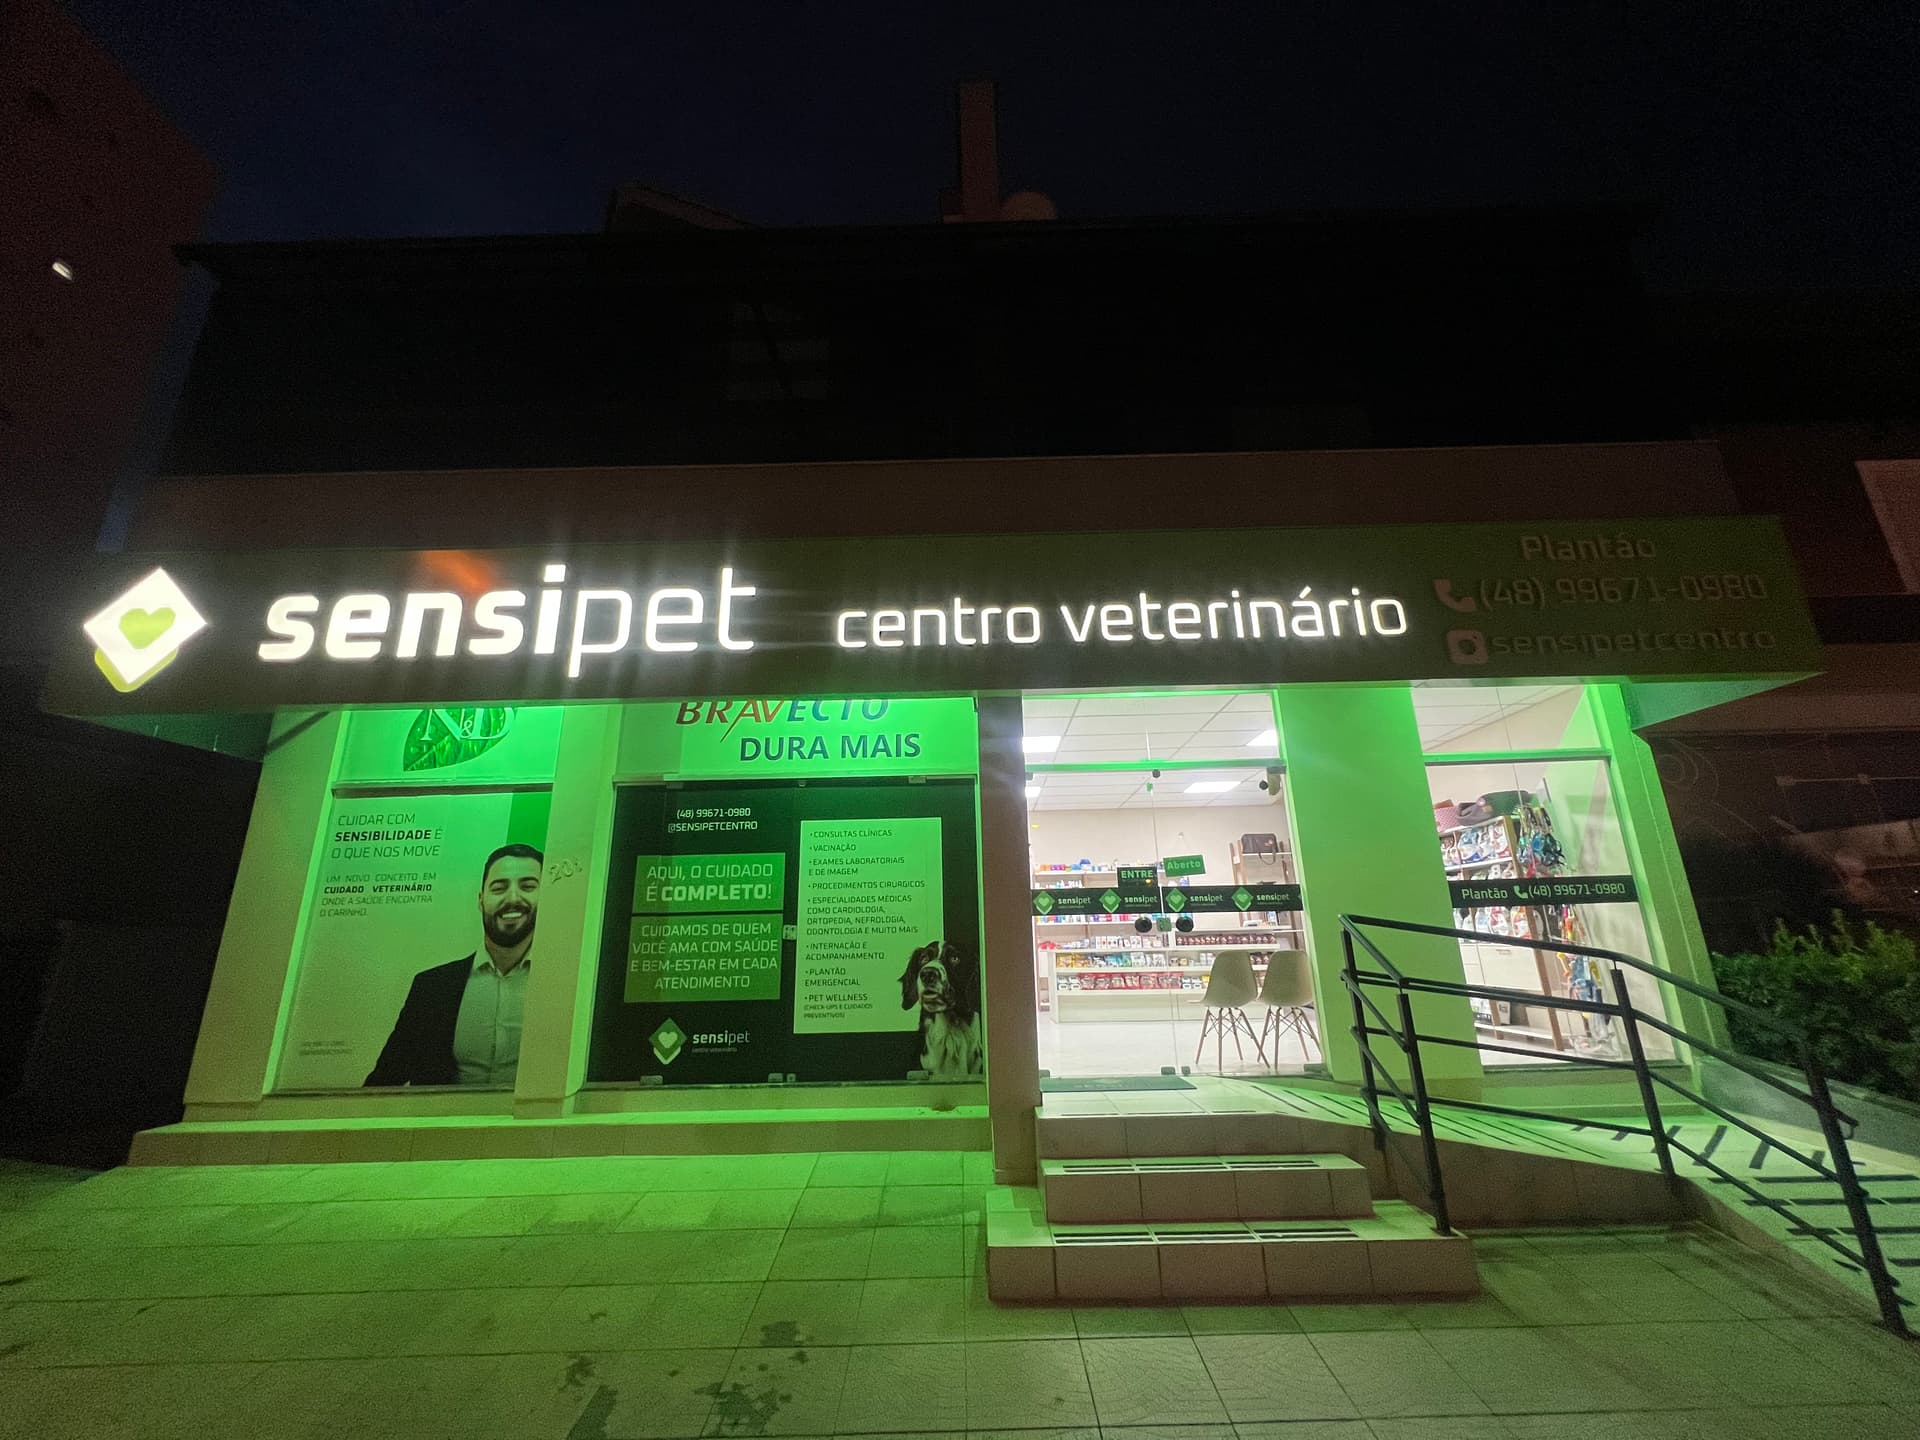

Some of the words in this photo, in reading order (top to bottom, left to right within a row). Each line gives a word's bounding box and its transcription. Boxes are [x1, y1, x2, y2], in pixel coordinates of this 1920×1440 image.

[1521, 533, 1656, 561] Plantão
[1480, 578, 1546, 610] (48)
[1555, 575, 1767, 602] 99671-0980
[259, 564, 756, 677] sensipet
[836, 598, 1042, 648] centro
[1060, 586, 1408, 642] veterinário
[1492, 628, 1776, 656] sensipetcentro
[675, 699, 889, 740] BRAVECTO
[740, 736, 829, 761] DURA
[841, 733, 920, 758] MAIS
[677, 809, 694, 819] (48)
[696, 808, 751, 817] 99671-0980
[338, 815, 384, 825] CUIDAR
[387, 814, 415, 824] COM
[668, 821, 758, 833] @SENSIPETCENTRO
[335, 830, 432, 841] SENSIBILIDADE
[435, 826, 443, 839] É
[859, 828, 892, 837] CLÍNICAS
[332, 848, 340, 858] O
[344, 847, 371, 860] QUE
[374, 846, 399, 857] NOS
[403, 845, 440, 856] MOVE
[813, 844, 856, 852] VACINAÇÃO
[846, 857, 904, 865] LABORATORIAIS
[1168, 861, 1200, 869] Aberto
[345, 874, 370, 882] NOVO
[375, 873, 418, 882] CONCEITO
[423, 872, 436, 880] EM
[647, 866, 685, 881] AQUI,
[691, 866, 700, 878] O
[706, 864, 773, 877] CUIDADO
[815, 868, 825, 876] DE
[1121, 870, 1153, 878] ENTRE
[324, 886, 364, 894] CUIDADO
[373, 883, 432, 892] VETERINÁRIO
[880, 880, 925, 888] CIRÚRGICOS
[647, 882, 658, 901] É
[662, 884, 771, 901] COMPLETO!
[1462, 886, 1508, 900] Plantão
[1528, 886, 1551, 898] (48)
[1554, 883, 1626, 896] 99671-0980
[386, 896, 432, 904] ENCONTRA
[813, 896, 876, 904] ESPECIALIDADES
[878, 894, 912, 902] MÉDICAS
[1058, 896, 1091, 905] sensipet
[1124, 895, 1158, 904] sensipet
[1190, 894, 1222, 902] sensipet
[1257, 893, 1289, 901] sensipet
[320, 909, 326, 917] O
[833, 906, 885, 914] CARDIOLOGIA,
[807, 917, 853, 925] ORTOPEDIA,
[855, 916, 905, 924] NEFROLOGIA,
[642, 924, 708, 936] CUIDAMOS
[713, 924, 729, 935] DE
[733, 923, 771, 936] QUEM
[872, 926, 896, 934] MUITO
[633, 940, 665, 954] VOCÊ
[669, 942, 698, 953] AMA
[702, 942, 731, 952] COM
[735, 938, 778, 952] SAÚDE
[810, 941, 860, 950] INTERNAÇÃO
[806, 952, 884, 960] ACOMPANHAMENTO
[631, 961, 639, 972] E
[643, 959, 715, 972] BEM-ESTAR
[720, 959, 738, 969] EM
[743, 958, 777, 969] CADA
[810, 967, 846, 975] PLANTÃO
[655, 976, 750, 989] ATENDIMENTO
[805, 978, 860, 986] EMERGENCIAL
[826, 993, 868, 1001] WELLNESS
[693, 1030, 750, 1045] sensipet
